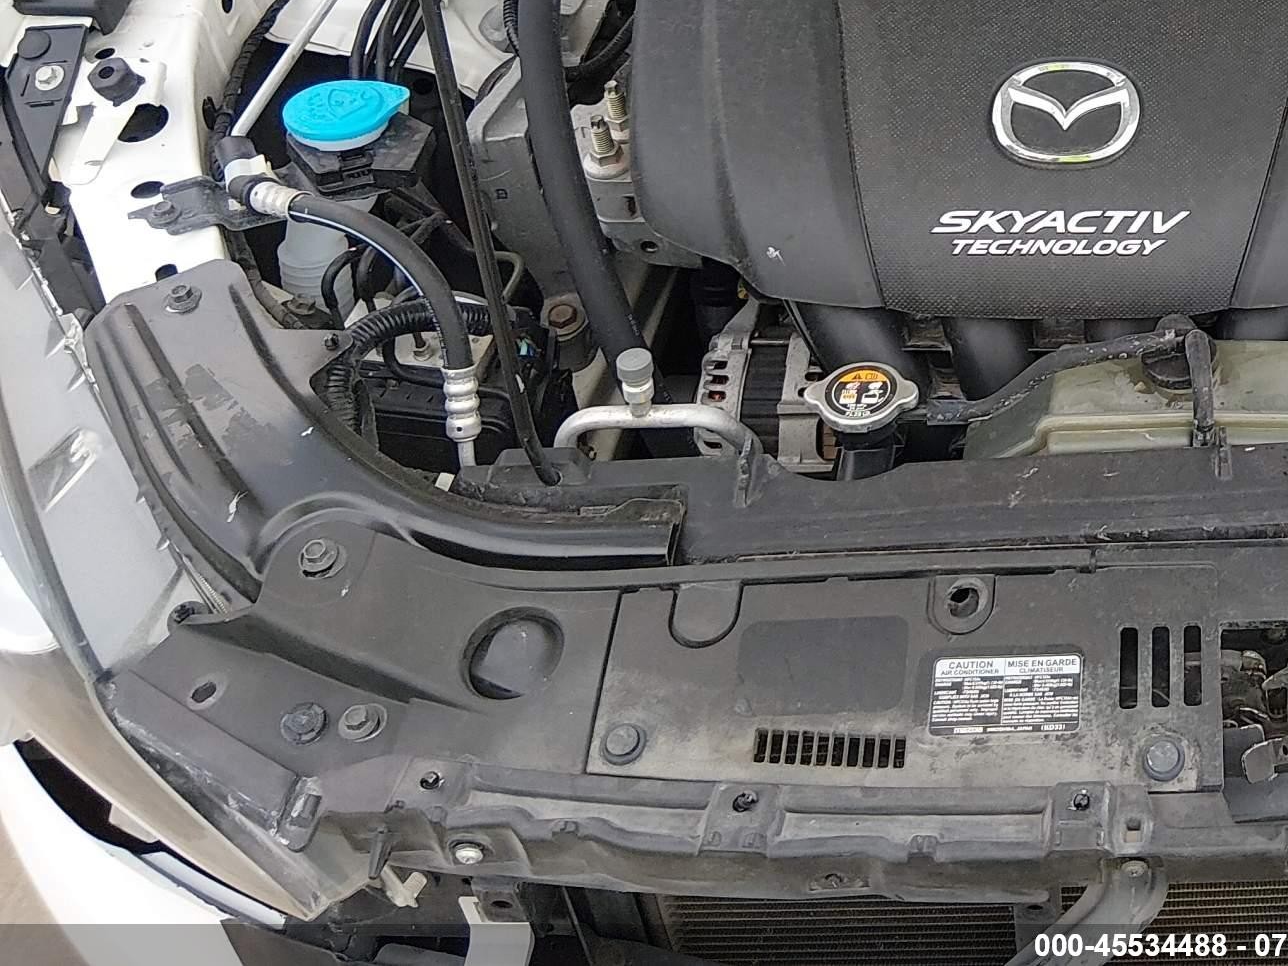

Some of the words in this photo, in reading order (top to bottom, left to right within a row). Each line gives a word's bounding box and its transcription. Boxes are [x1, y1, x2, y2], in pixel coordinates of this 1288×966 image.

[930, 210, 1191, 235] SKYACTIV
[951, 239, 1167, 256] TECHNOLOGY
[948, 660, 994, 670] CAUTION
[1007, 659, 1030, 668] MISE
[1031, 659, 1044, 667] EN
[1045, 658, 1077, 667] GARDE
[1019, 666, 1064, 674] CLIMATISEUR
